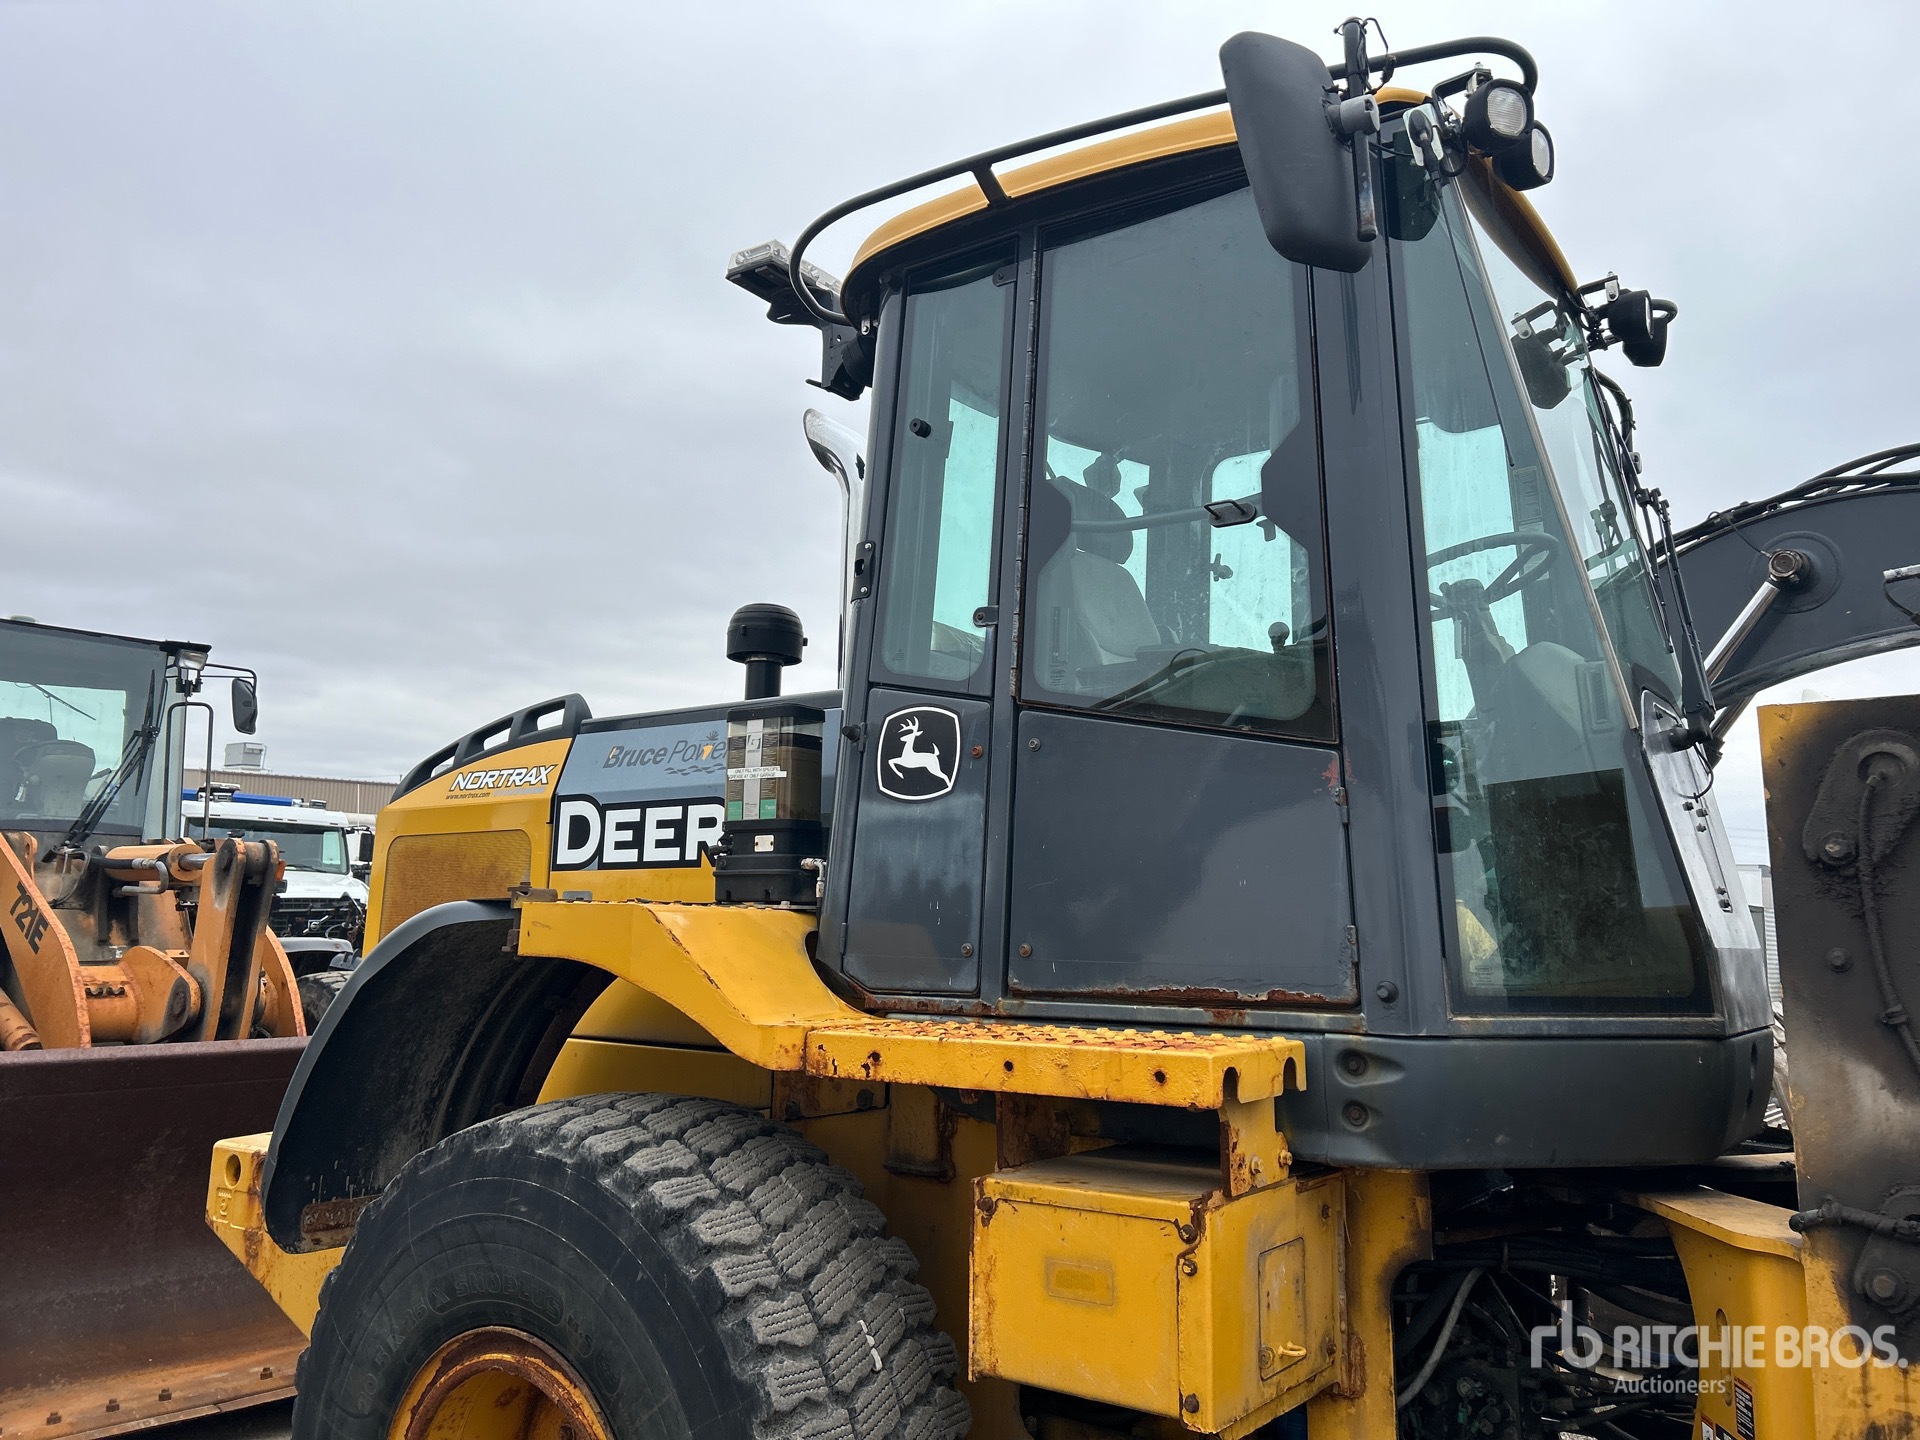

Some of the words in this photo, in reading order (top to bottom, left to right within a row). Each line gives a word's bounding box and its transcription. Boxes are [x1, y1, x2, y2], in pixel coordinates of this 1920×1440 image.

[602, 745, 668, 769] Bruce
[449, 763, 560, 792] NORTRAX
[445, 792, 491, 800] www.nortrax.com
[9, 880, 49, 955] 721E
[455, 1271, 564, 1320] SNOPLUS
